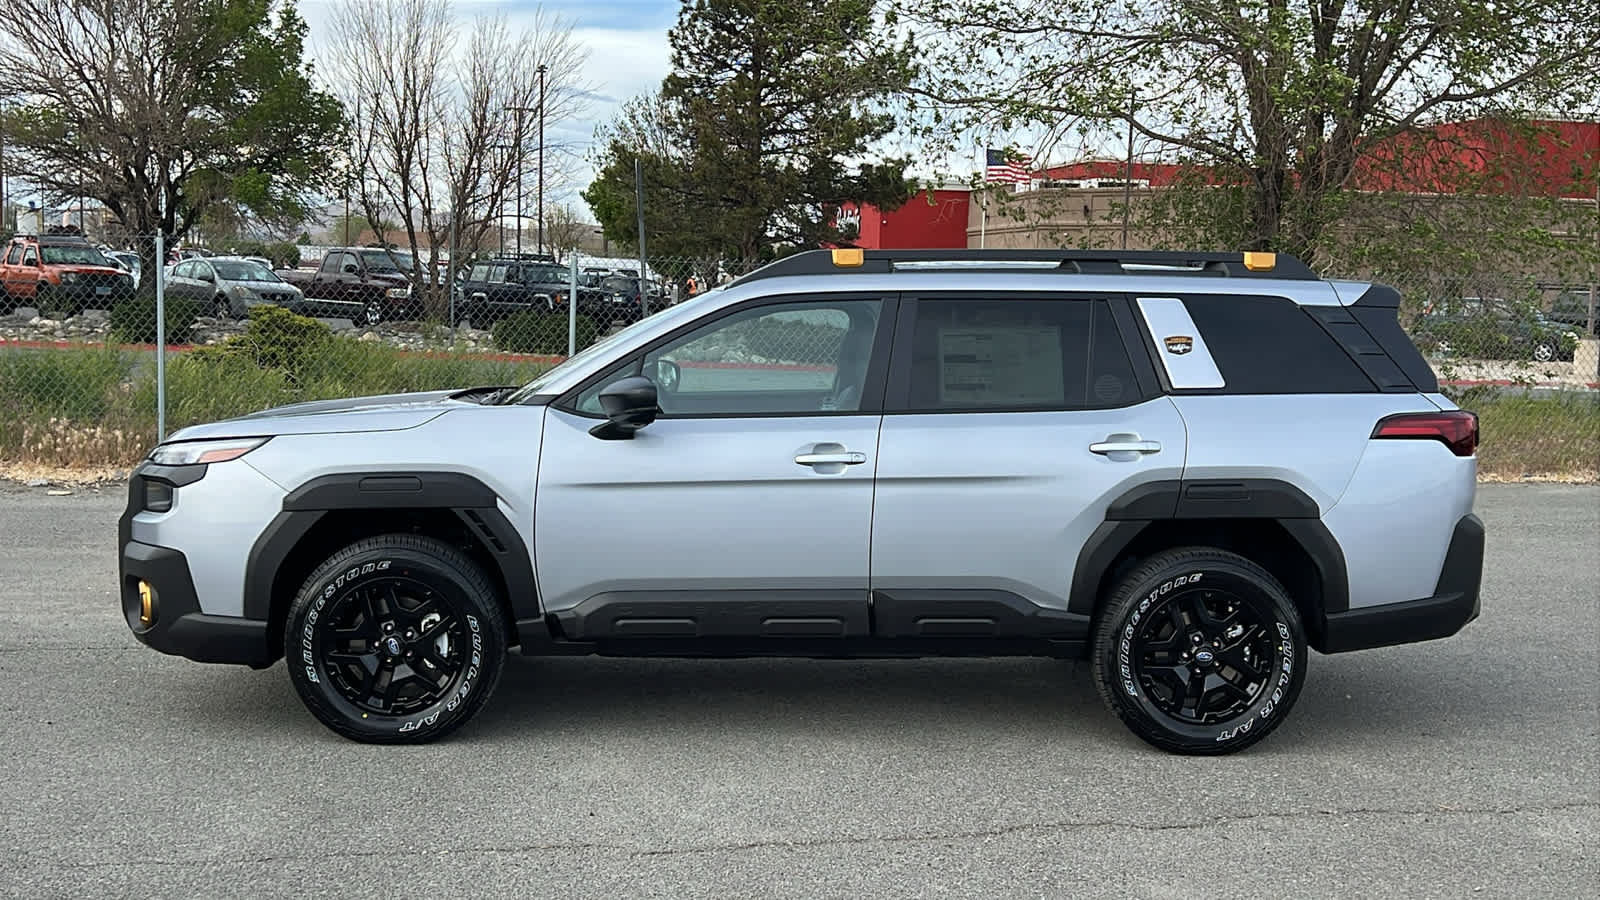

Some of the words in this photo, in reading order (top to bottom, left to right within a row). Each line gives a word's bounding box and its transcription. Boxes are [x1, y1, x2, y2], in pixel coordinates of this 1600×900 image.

[300, 560, 392, 684] BRIDGESTONE
[447, 614, 484, 712] DUELER
[1119, 572, 1203, 697] BRIDGESTONE
[1260, 621, 1295, 719] DUELER
[399, 711, 440, 732] A/T
[1215, 718, 1255, 742] A/T
